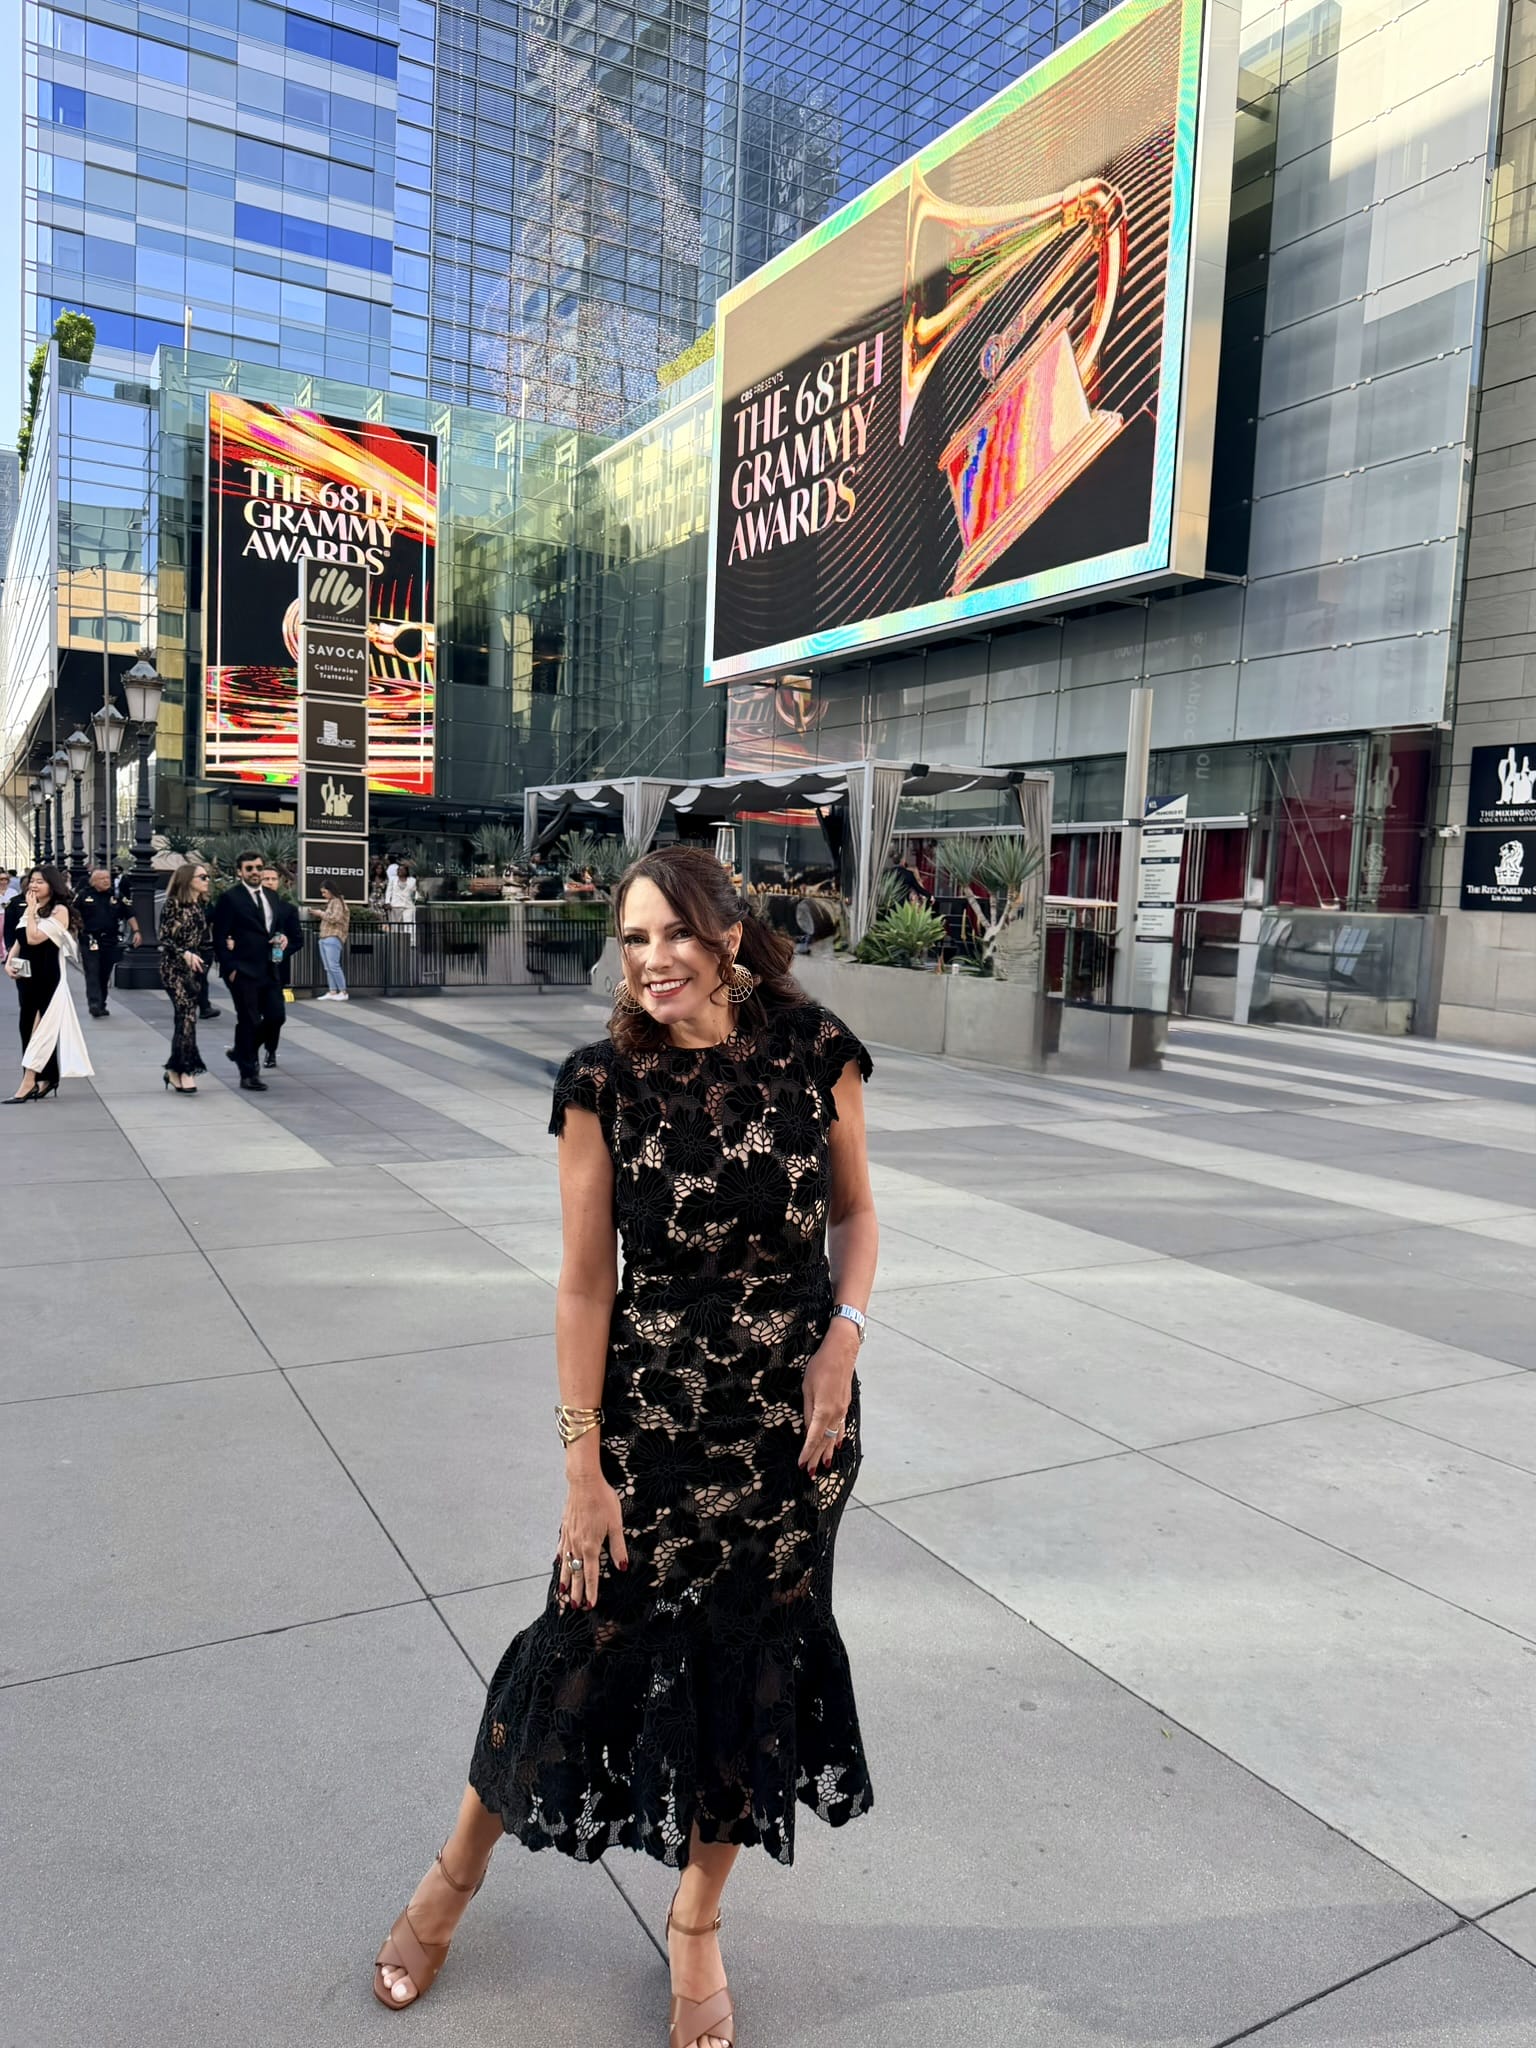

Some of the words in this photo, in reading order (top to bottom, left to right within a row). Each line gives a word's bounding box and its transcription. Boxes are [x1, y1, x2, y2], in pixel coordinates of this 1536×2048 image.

[734, 385, 790, 457] THE
[795, 332, 884, 425] 68TH
[731, 394, 877, 510] GRAMMY
[243, 467, 312, 505] THE
[318, 481, 404, 520] 68TH
[728, 465, 857, 566] AWARDS
[243, 499, 399, 548] GRAMMY
[310, 567, 364, 615] illy
[308, 643, 365, 660] SAVOCA
[314, 663, 359, 674] Californian
[319, 672, 354, 682] Trattoria
[306, 866, 365, 877] SENDERO
